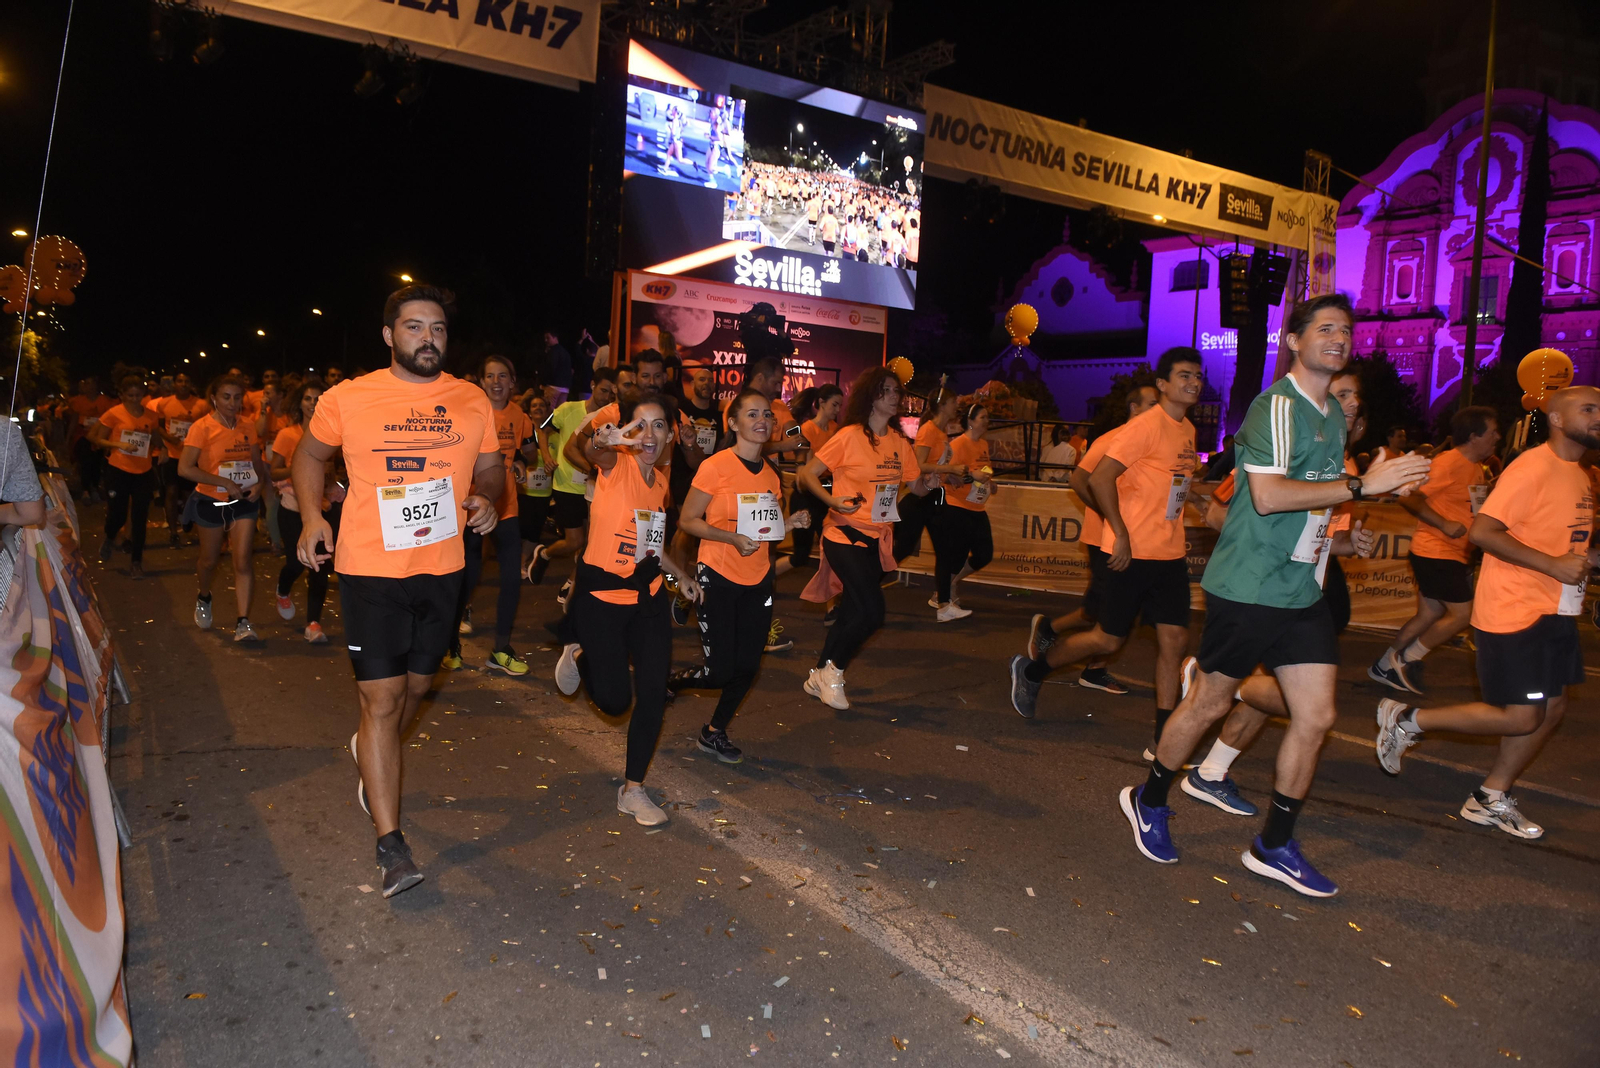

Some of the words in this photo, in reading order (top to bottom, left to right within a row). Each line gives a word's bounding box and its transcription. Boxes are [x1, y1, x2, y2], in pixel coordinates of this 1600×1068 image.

[929, 112, 1065, 172] NOCTURNA
[1072, 151, 1160, 196] SEVILLA
[684, 289, 699, 298] ABC
[706, 293, 738, 304] Cruzcampo
[383, 424, 427, 432] SEVILLA
[697, 437, 711, 445] 2881
[402, 501, 438, 522] 9527
[751, 509, 778, 521] 11759
[1022, 515, 1082, 542] IMD
[1000, 552, 1043, 564] Instituto
[1046, 557, 1090, 569] Municip
[1016, 564, 1030, 573] de
[1355, 583, 1413, 598] Deportes
